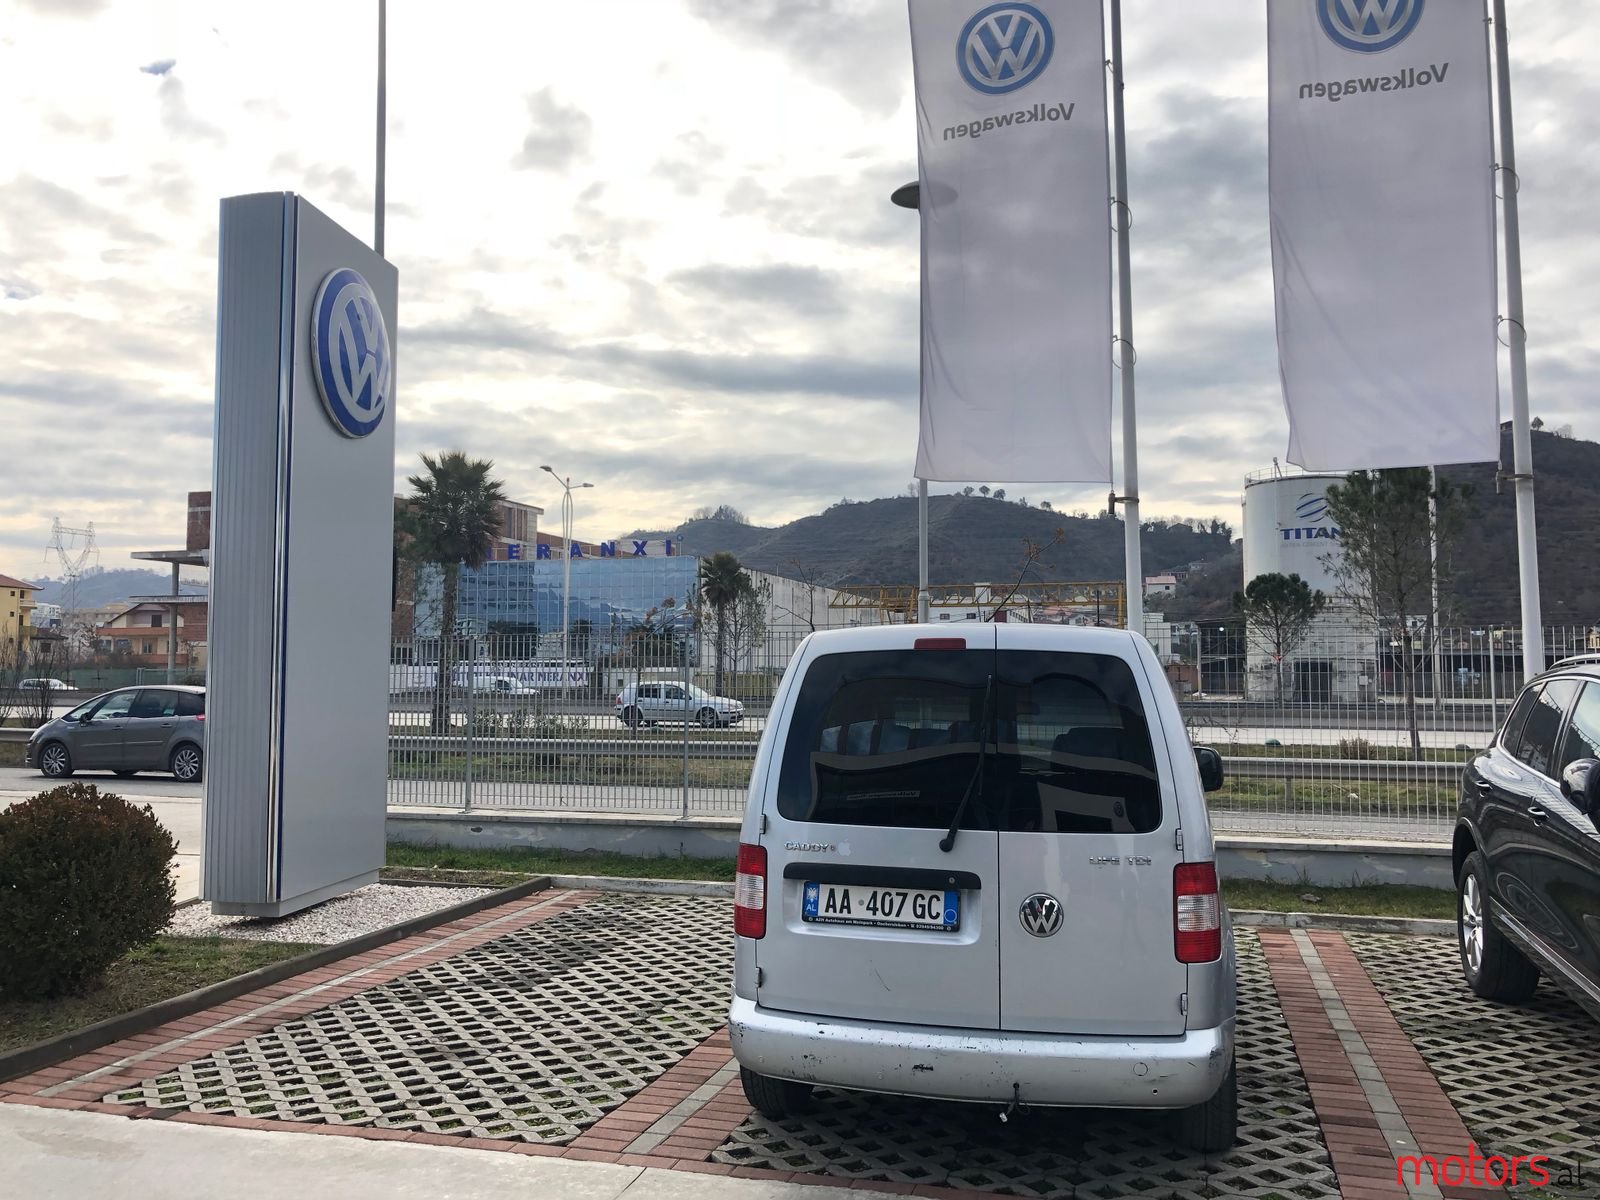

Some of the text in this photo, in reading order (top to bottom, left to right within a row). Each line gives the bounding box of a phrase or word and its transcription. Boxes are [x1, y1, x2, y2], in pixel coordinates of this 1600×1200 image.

[965, 10, 1045, 87] VW
[329, 281, 388, 423] VW
[784, 840, 830, 853] CADDY
[806, 903, 817, 912] AL
[824, 887, 941, 920] AA 407 GC
[1021, 894, 1062, 936] VW
